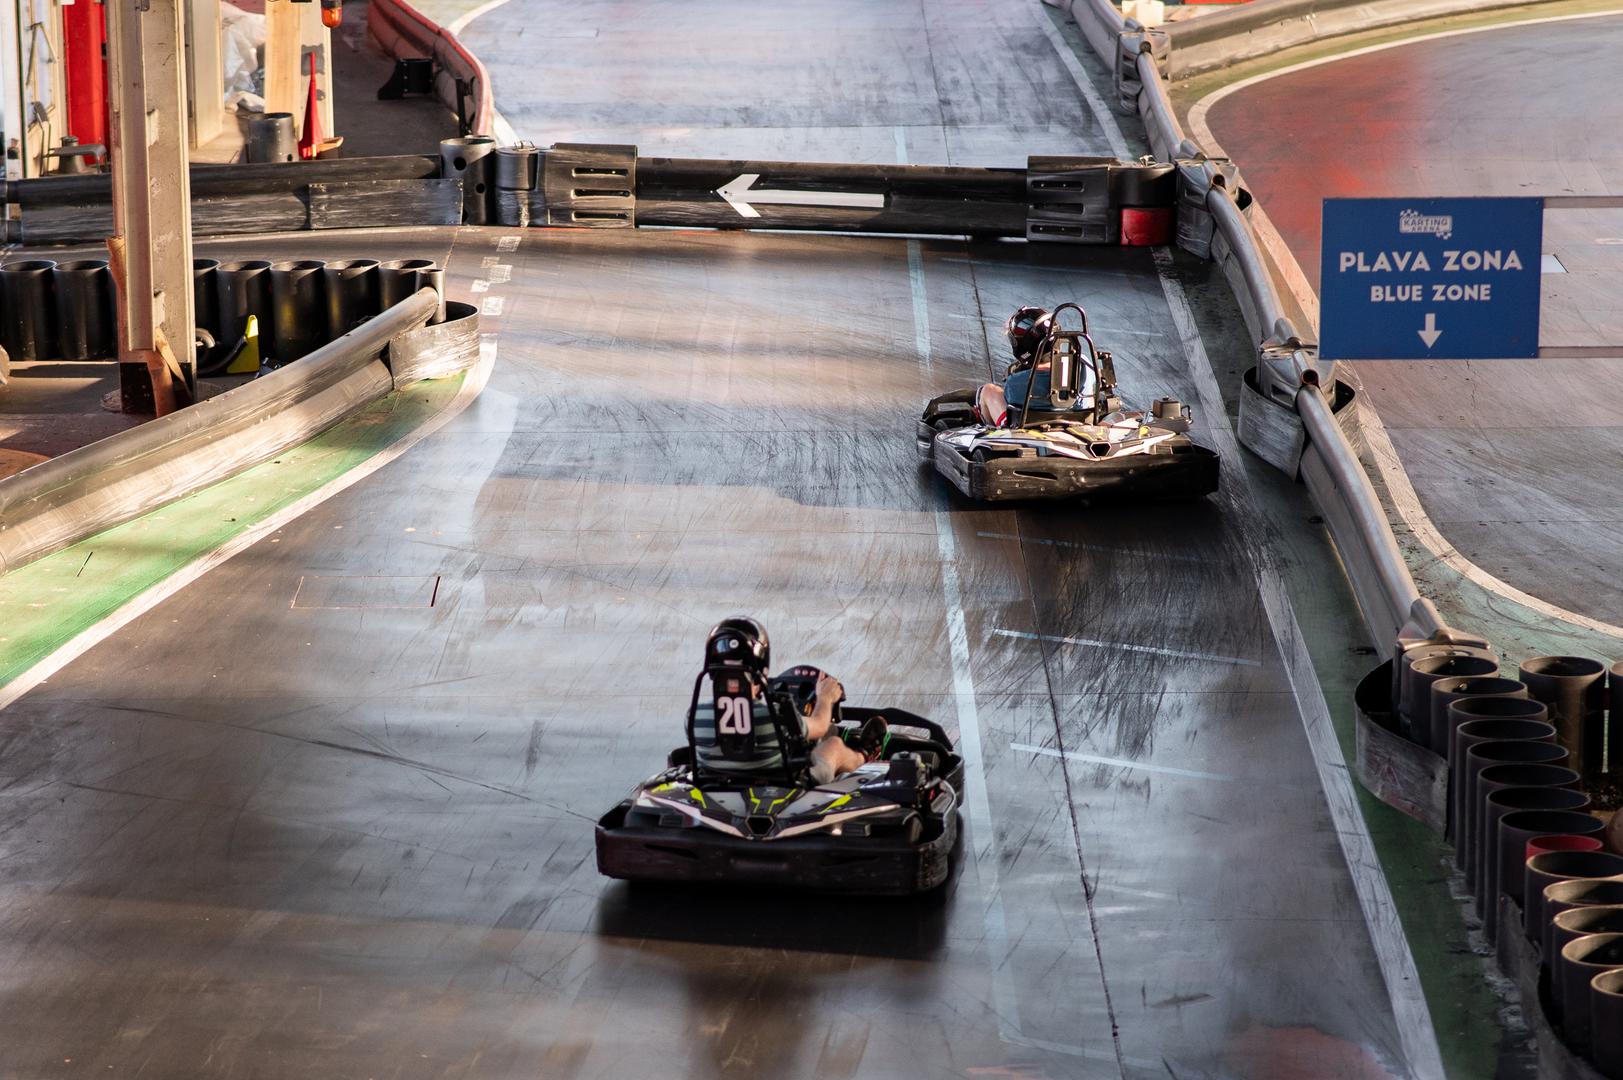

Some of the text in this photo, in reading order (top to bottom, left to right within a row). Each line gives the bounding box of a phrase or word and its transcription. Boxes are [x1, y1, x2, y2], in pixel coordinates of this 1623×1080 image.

[1340, 250, 1523, 272] PLAVA ZONA
[1370, 284, 1491, 302] BLUE ZONE
[1061, 356, 1069, 387] 1
[718, 697, 751, 734] 20
